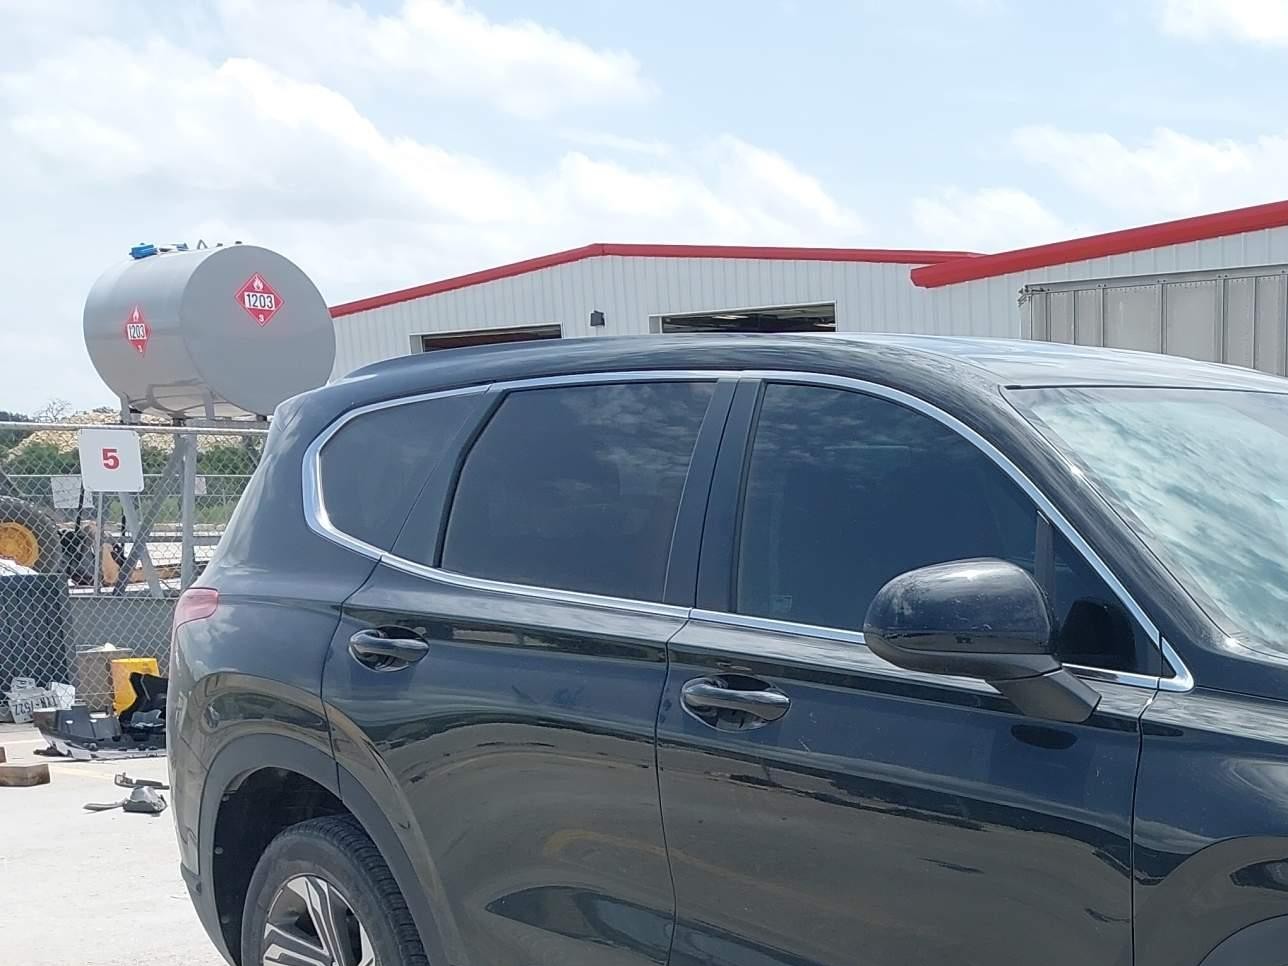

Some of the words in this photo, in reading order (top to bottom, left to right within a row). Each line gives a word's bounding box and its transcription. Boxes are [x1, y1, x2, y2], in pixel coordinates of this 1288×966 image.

[246, 293, 274, 309] 1203
[258, 313, 265, 322] 3
[129, 324, 145, 339] 1203
[102, 448, 119, 470] 5
